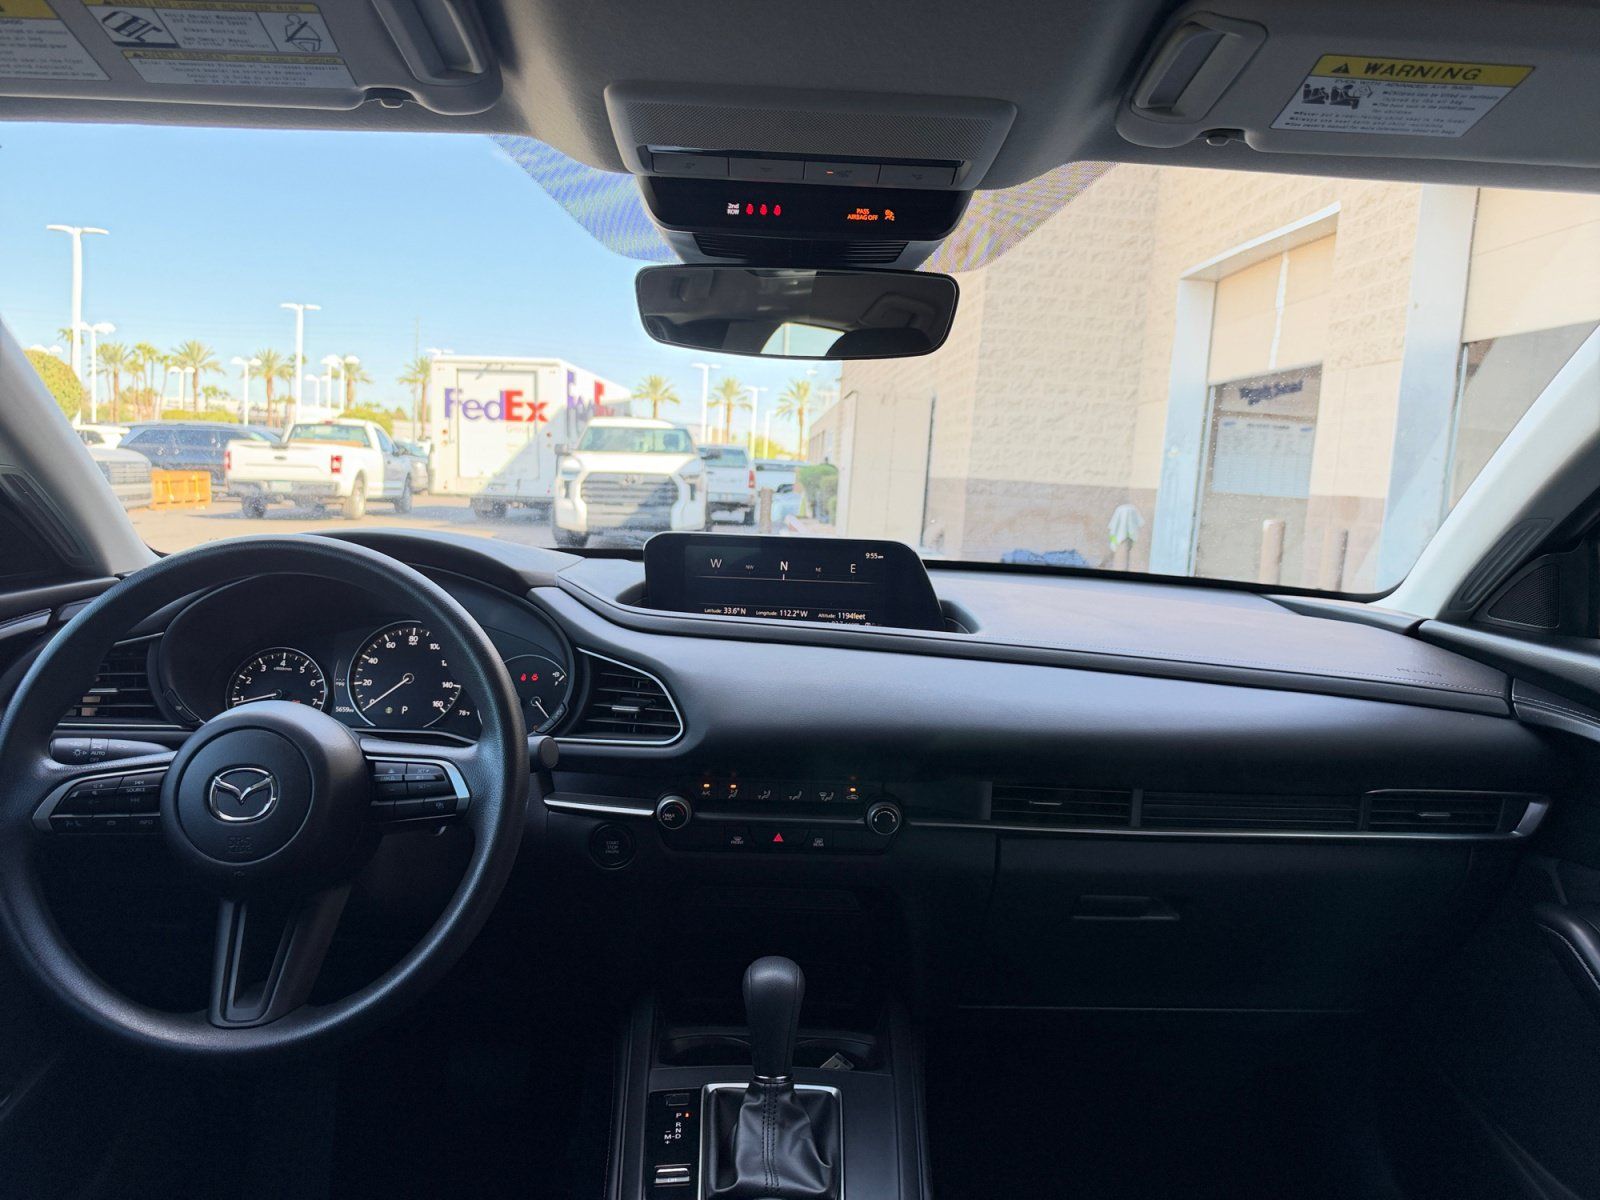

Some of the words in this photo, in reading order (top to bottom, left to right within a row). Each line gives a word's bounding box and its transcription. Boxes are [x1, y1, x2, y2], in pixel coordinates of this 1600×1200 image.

[1364, 62, 1482, 81] WARNING
[444, 388, 548, 422] FedEx
[710, 558, 722, 568] W
[780, 560, 788, 571] N
[850, 564, 856, 574] E
[401, 706, 408, 714] P
